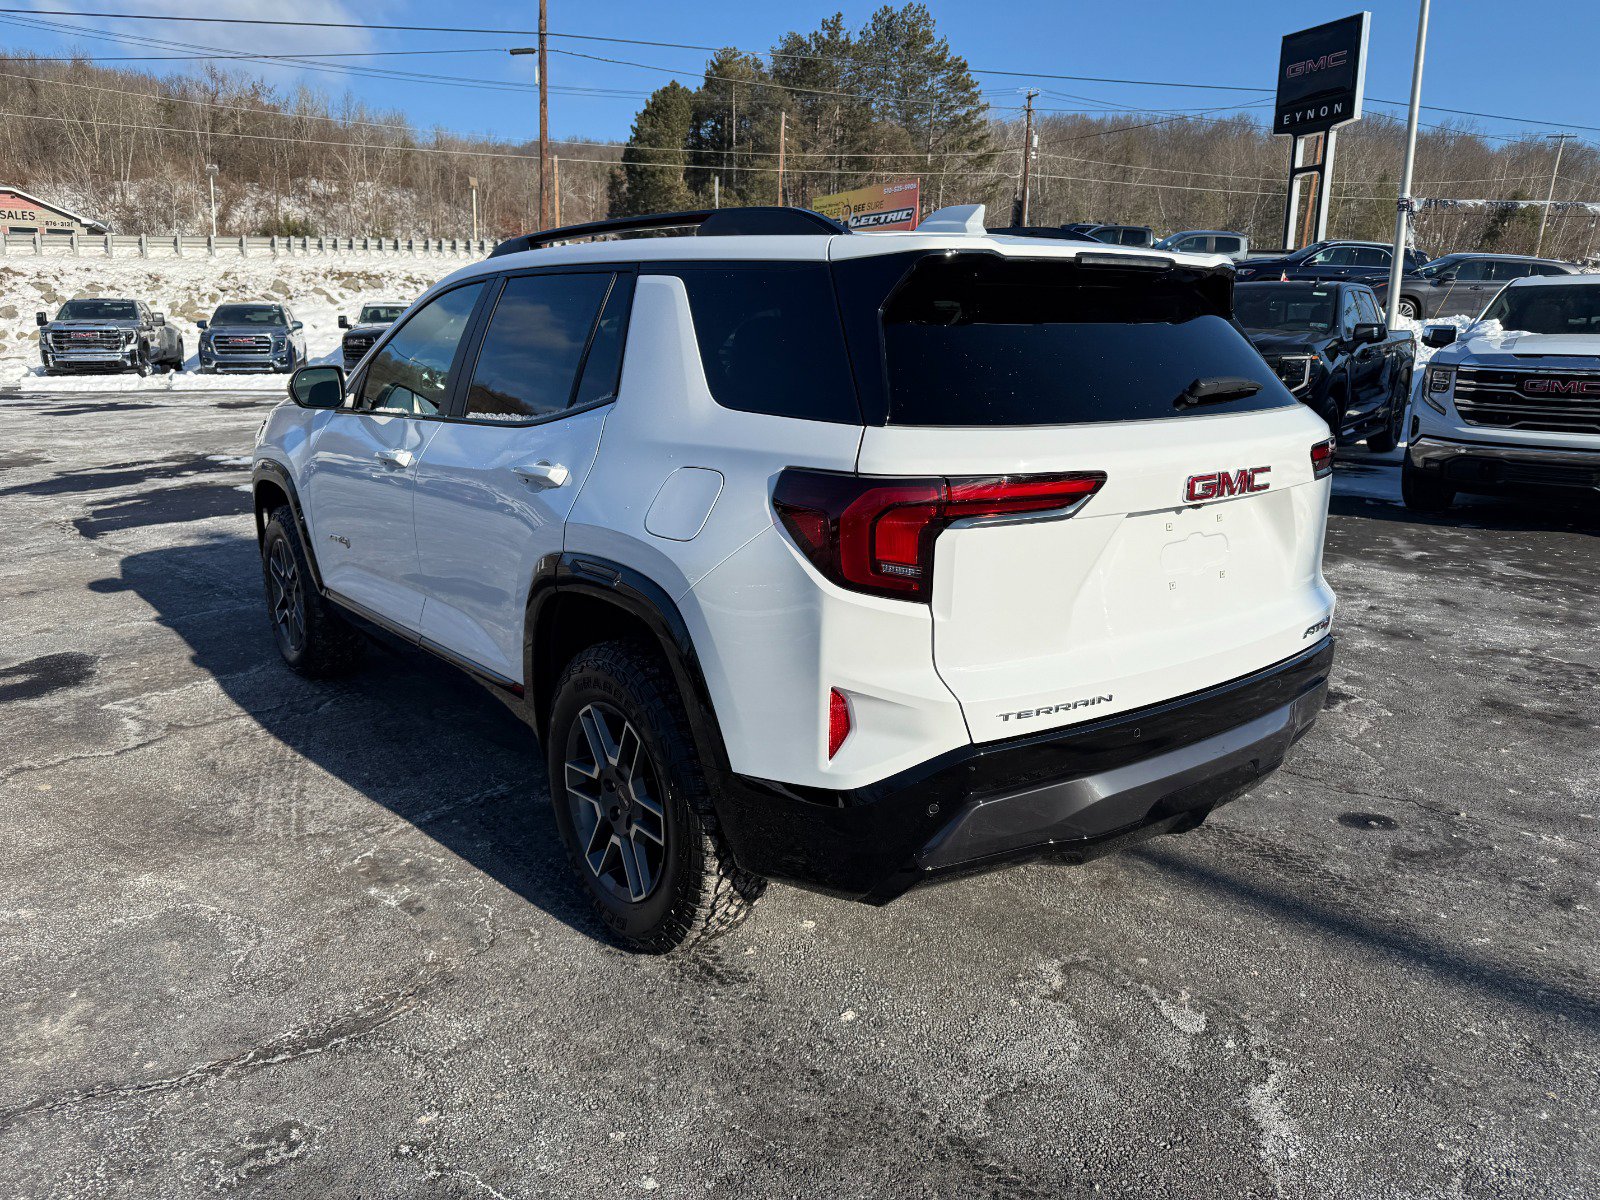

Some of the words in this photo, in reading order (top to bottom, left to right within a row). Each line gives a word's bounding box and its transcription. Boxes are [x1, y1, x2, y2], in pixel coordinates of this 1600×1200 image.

[1286, 50, 1347, 79] GMC
[1283, 102, 1342, 125] EYNON
[0, 210, 36, 221] SALES
[853, 204, 866, 213] BEE
[866, 200, 884, 211] SURE
[1524, 379, 1600, 395] GMC
[1183, 465, 1271, 503] GMC
[996, 694, 1113, 721] TERRAIN
